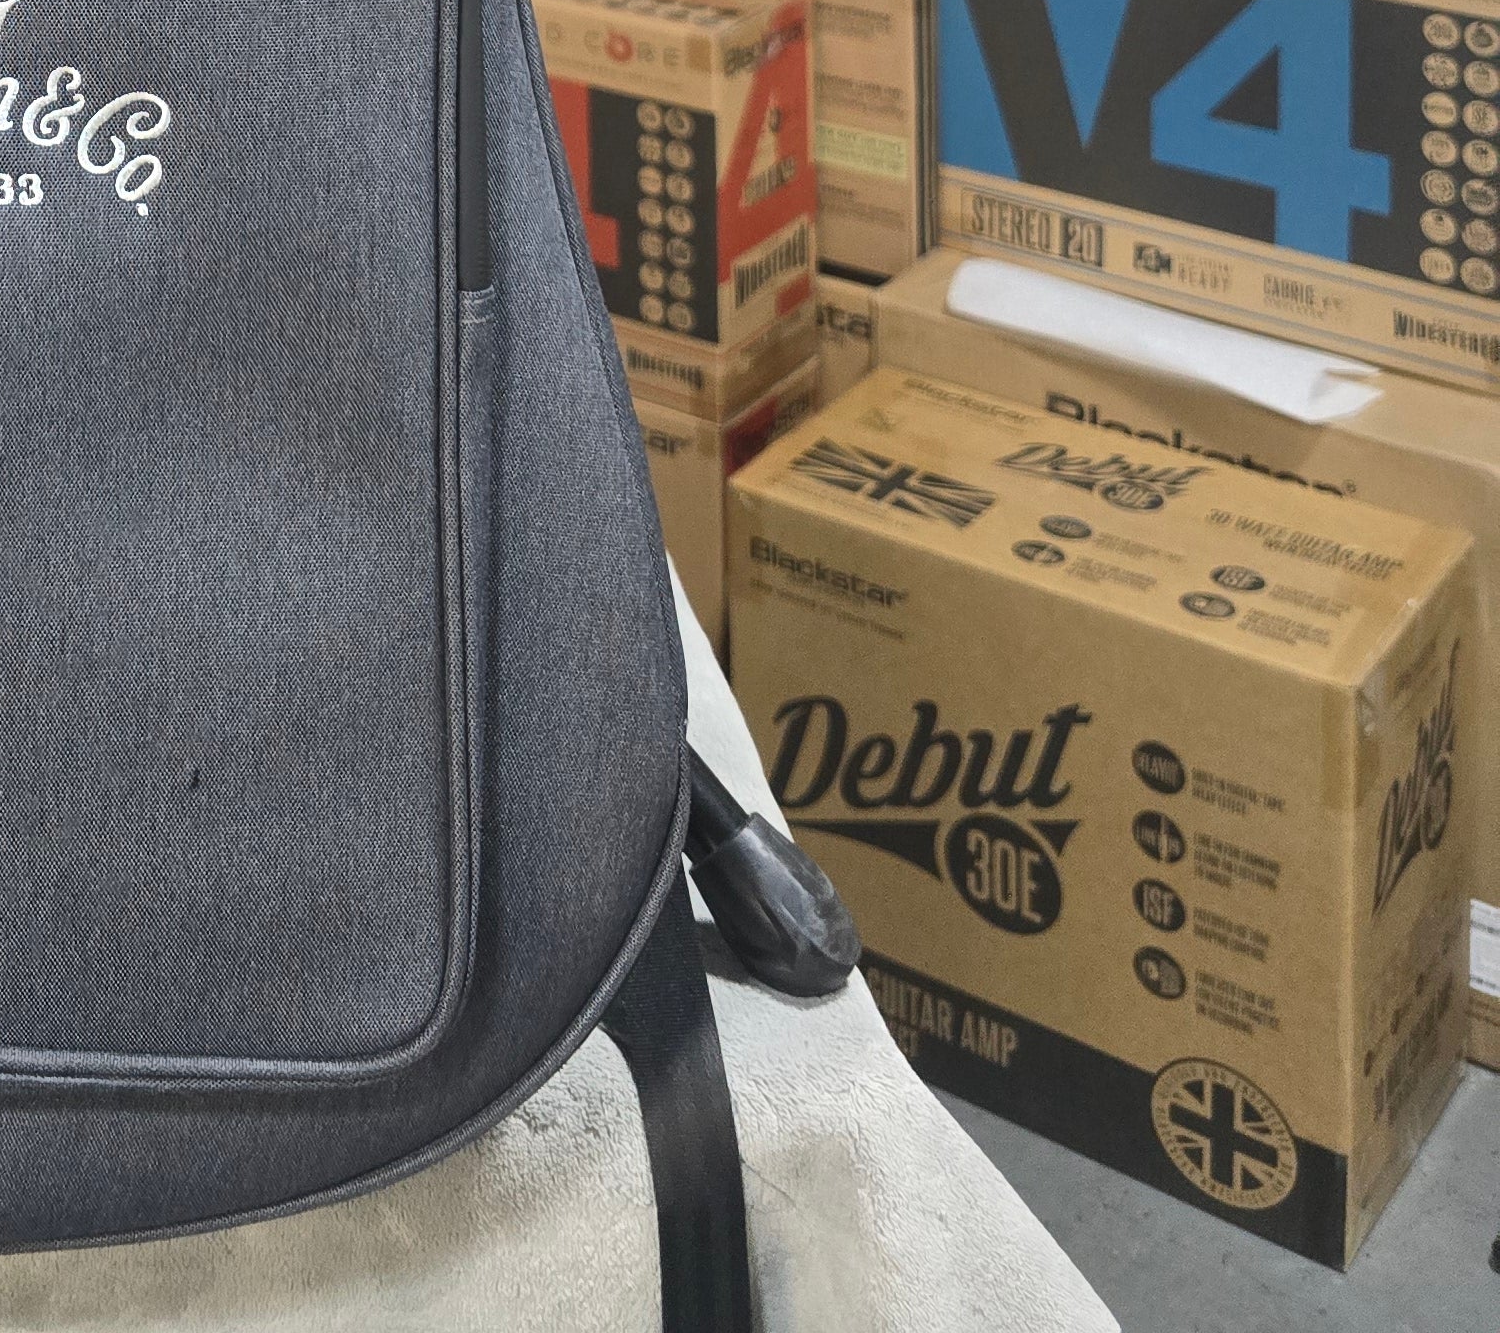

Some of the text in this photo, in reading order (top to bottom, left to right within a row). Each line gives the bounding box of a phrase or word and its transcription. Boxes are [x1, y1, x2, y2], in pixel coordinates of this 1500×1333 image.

[971, 194, 1052, 253] STEREO
[770, 695, 1093, 810] Debut
[965, 829, 1043, 924] 30E
[960, 1009, 1019, 1069] AMP
